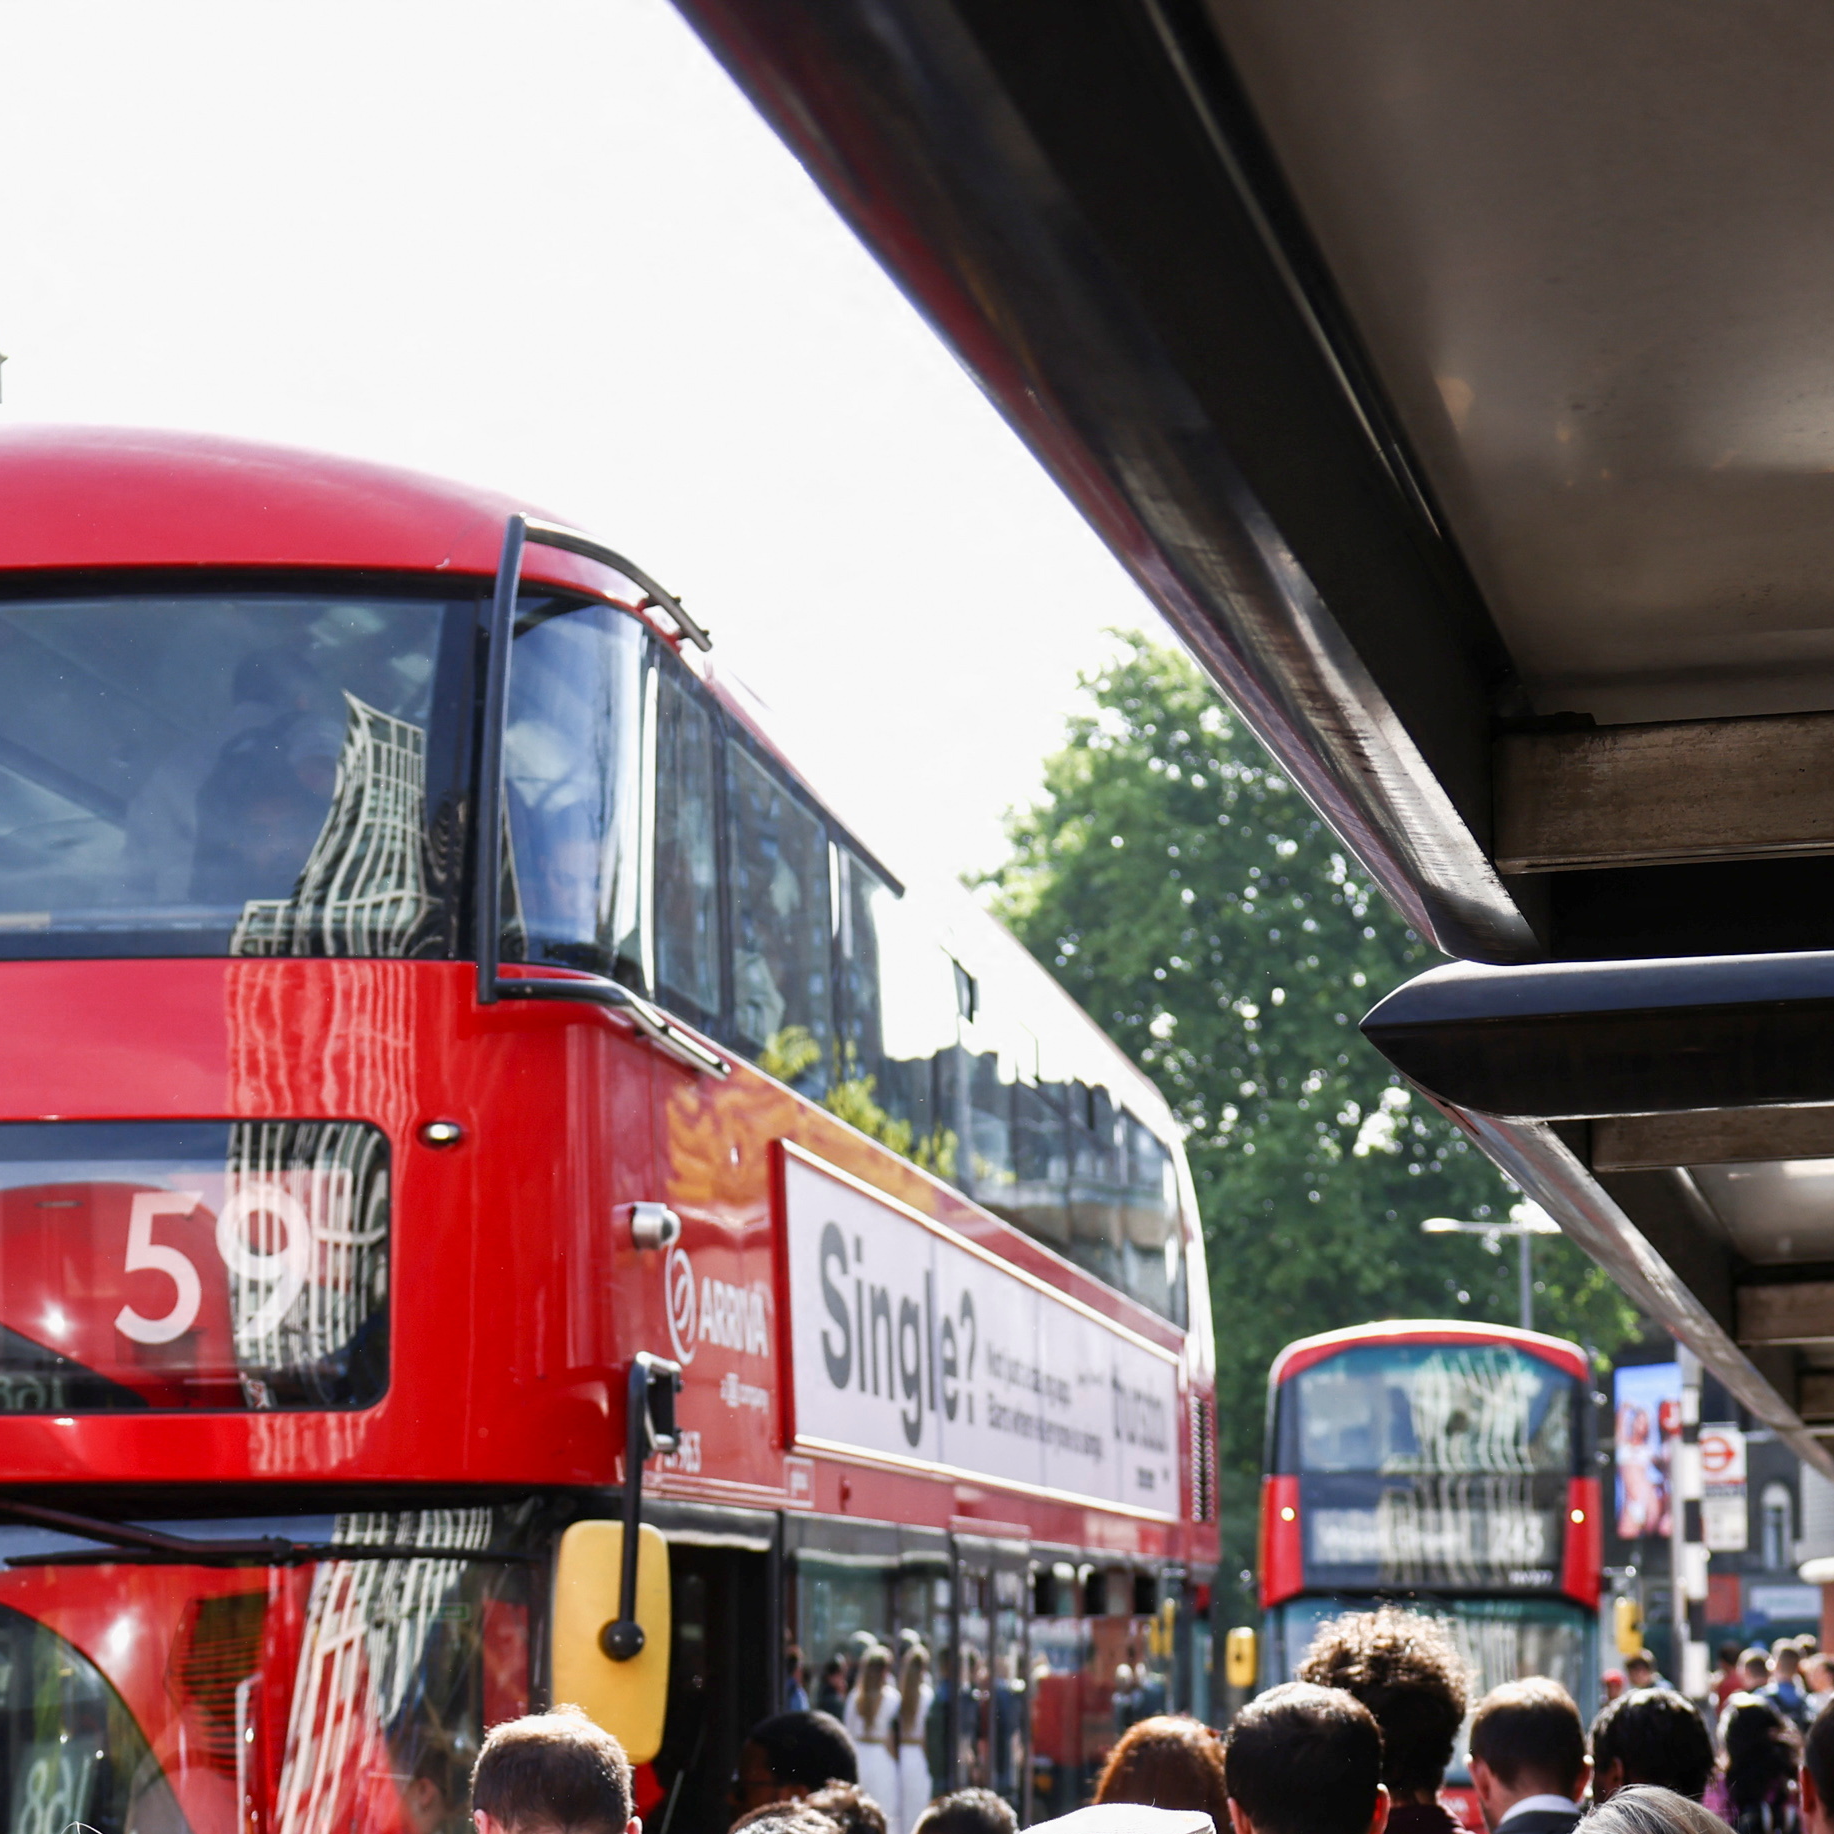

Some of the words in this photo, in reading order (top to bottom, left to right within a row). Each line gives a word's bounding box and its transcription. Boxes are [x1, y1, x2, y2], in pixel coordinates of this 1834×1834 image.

[114, 1181, 311, 1345] 59
[698, 1275, 769, 1358] ARRIVA
[819, 1221, 976, 1448] Single?
